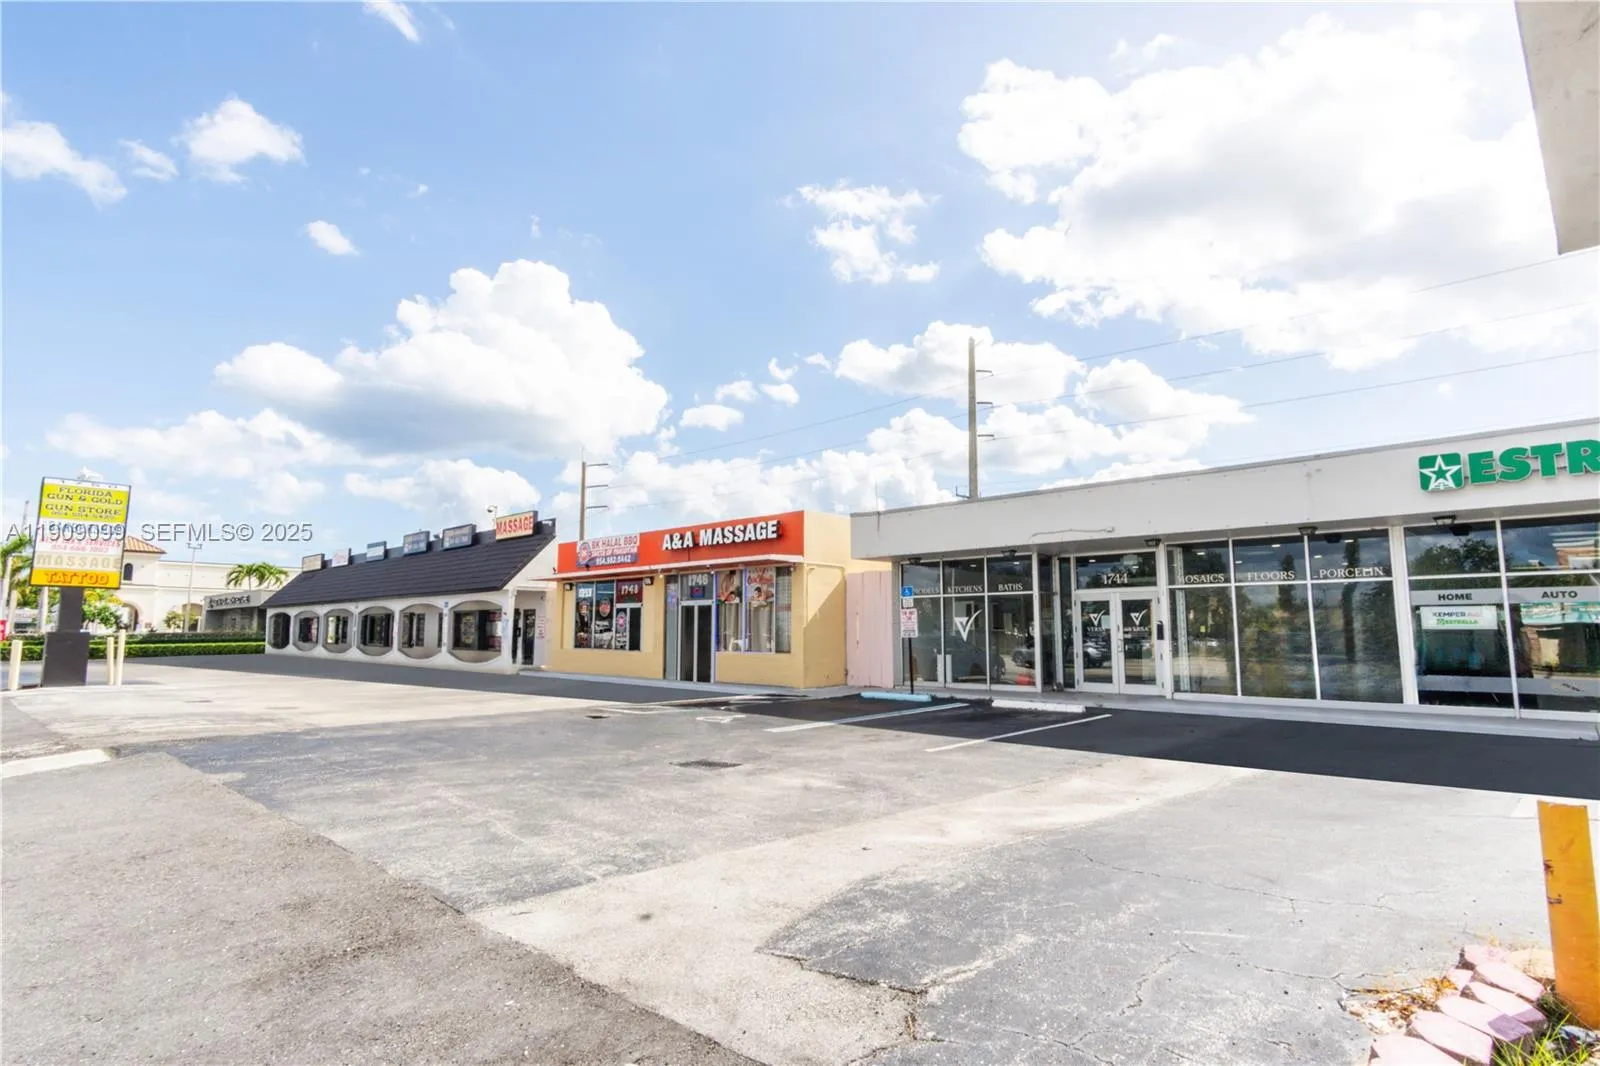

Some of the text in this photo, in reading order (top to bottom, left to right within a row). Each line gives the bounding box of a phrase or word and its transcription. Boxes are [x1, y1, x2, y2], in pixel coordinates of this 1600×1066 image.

[1467, 439, 1600, 483] ESTR
[59, 487, 112, 498] FLORIDA
[47, 493, 73, 501] GUN
[91, 497, 123, 506] GOLD
[45, 503, 121, 517] GUN STORE
[496, 516, 533, 536] MASSAGE
[602, 536, 621, 547] HALAL
[623, 535, 638, 545] BBQ
[662, 520, 778, 551] A&A MASSAGE
[36, 554, 121, 570] MASSAGE
[44, 571, 110, 585] TATTOO
[1103, 572, 1128, 585] 1744
[1177, 573, 1225, 585] MOSAICS
[1247, 570, 1296, 581] FLOORS
[947, 584, 983, 593] KITCHENS
[998, 582, 1024, 592] BATHS
[1437, 592, 1473, 601] HOME
[1541, 590, 1578, 599] AUTO
